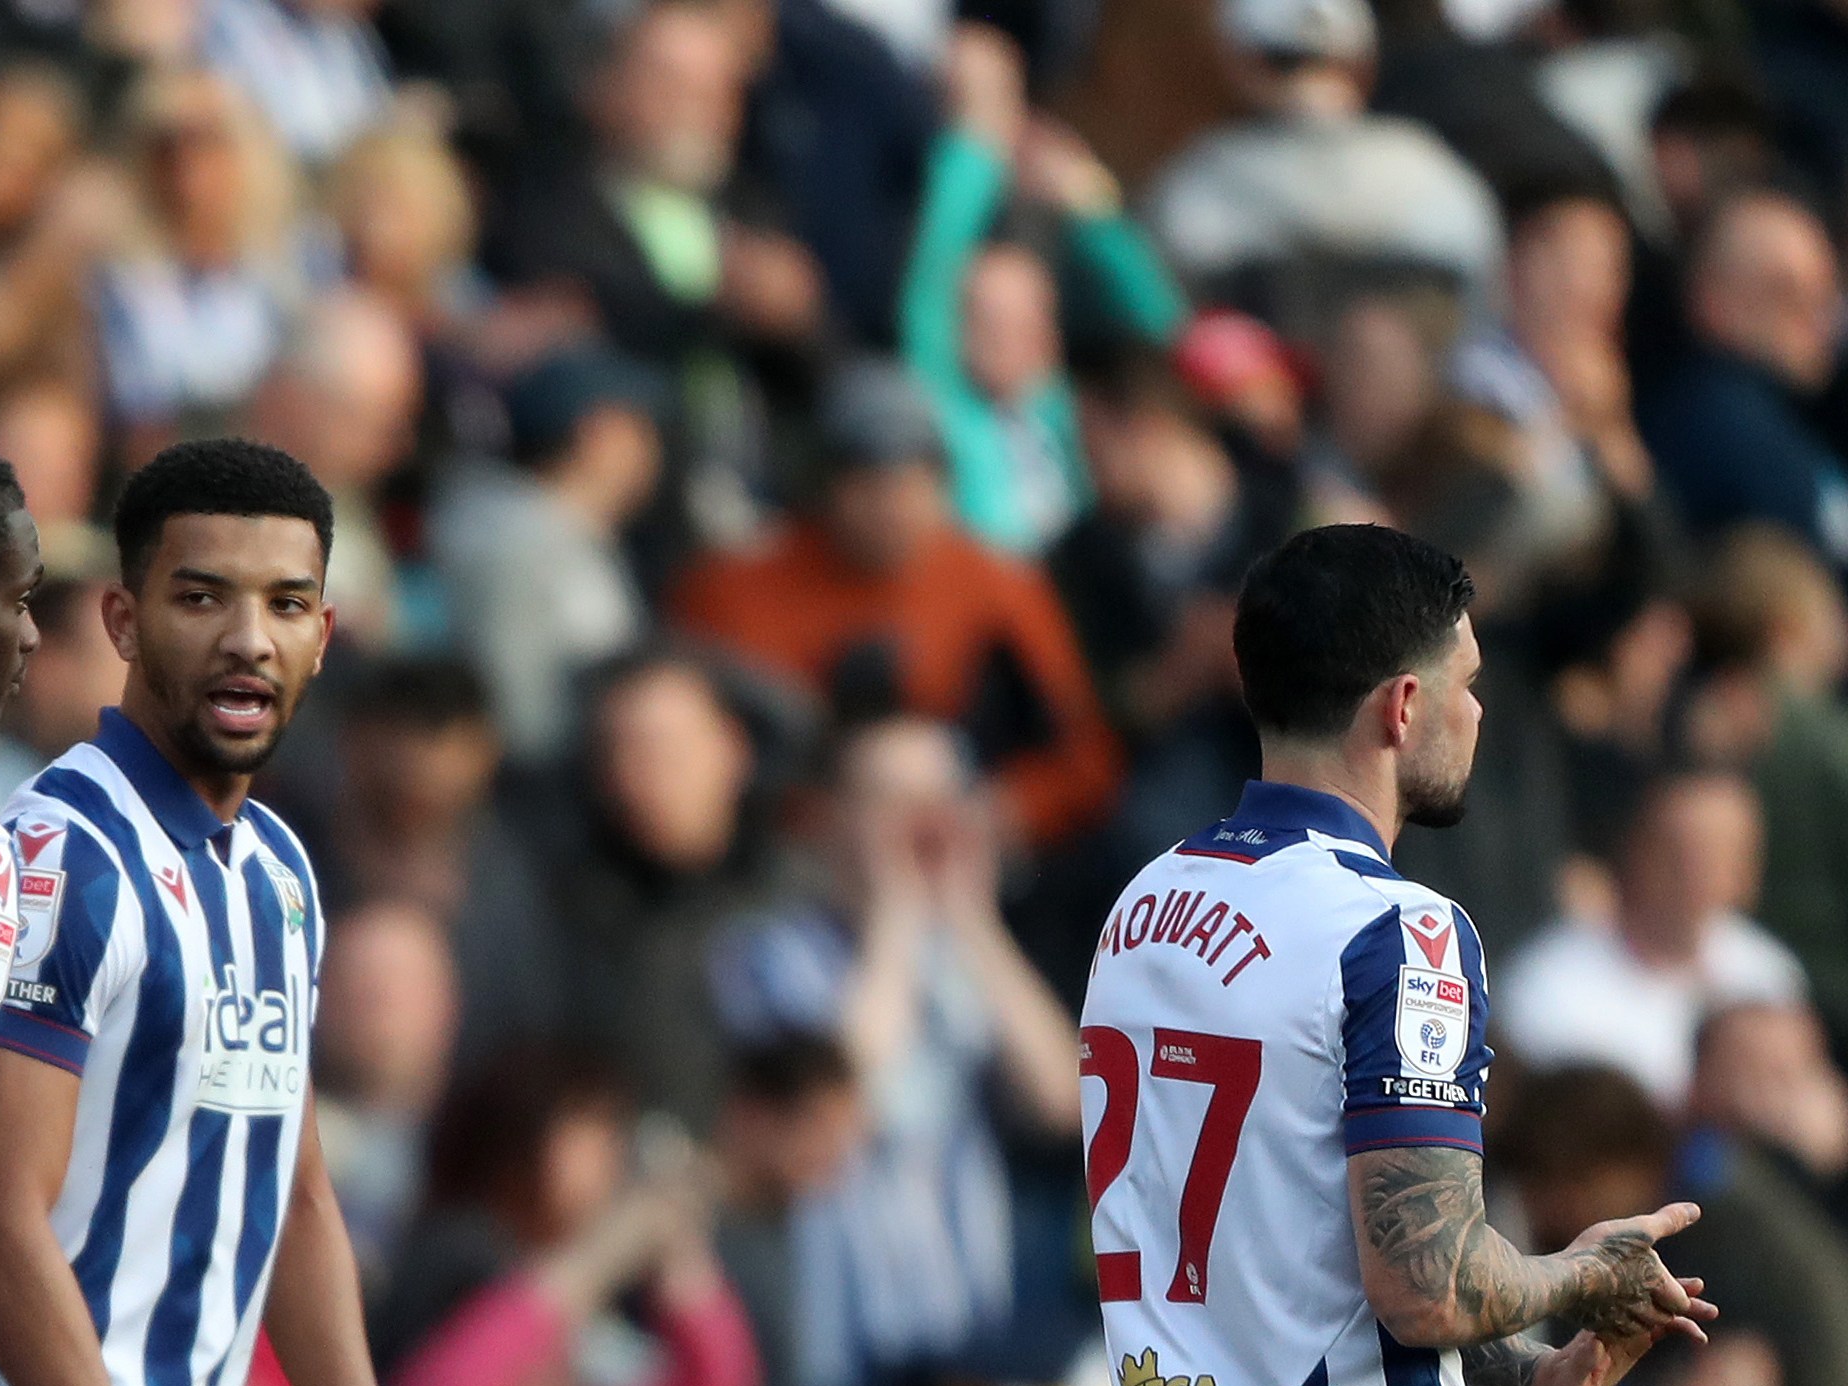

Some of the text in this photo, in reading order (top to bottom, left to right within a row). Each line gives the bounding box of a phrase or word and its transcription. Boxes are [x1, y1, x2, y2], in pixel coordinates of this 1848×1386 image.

[1092, 888, 1272, 987] MOWATT
[10, 980, 57, 1003] THER
[1407, 976, 1462, 1001] sky bet
[1420, 1050, 1442, 1067] EFL
[1079, 1025, 1263, 1304] 27
